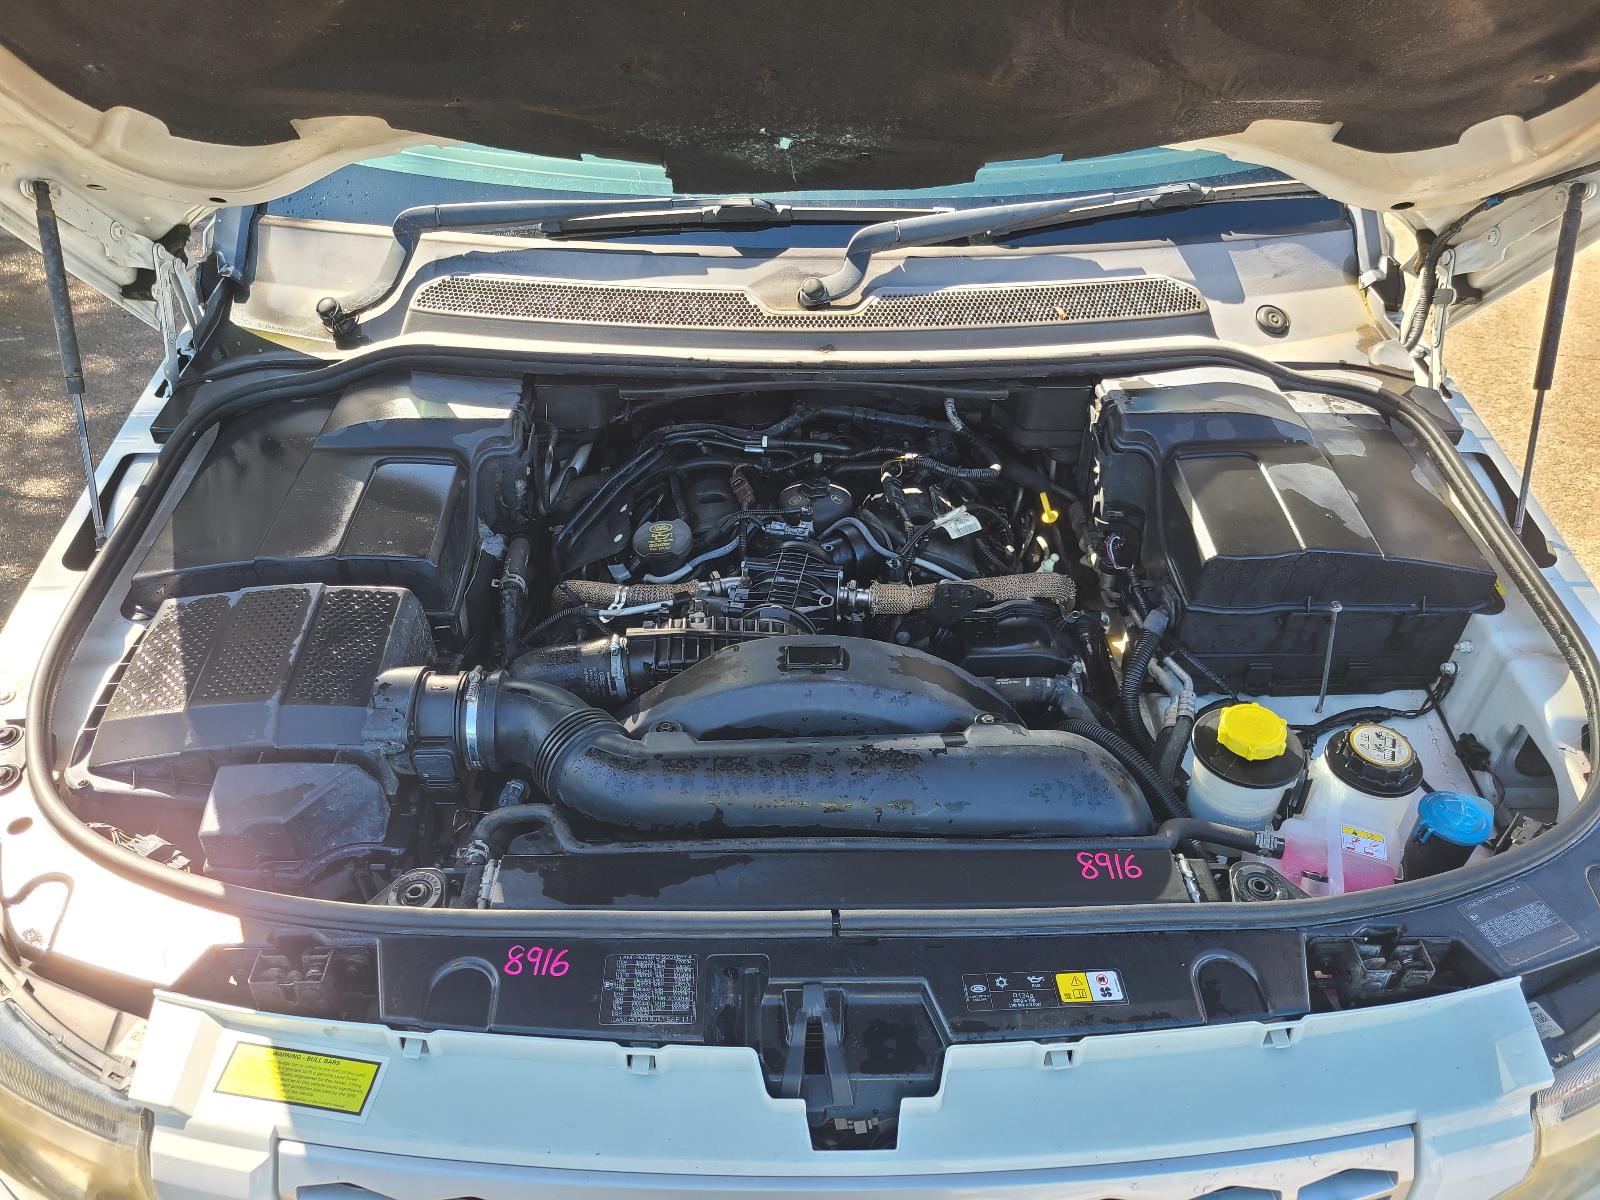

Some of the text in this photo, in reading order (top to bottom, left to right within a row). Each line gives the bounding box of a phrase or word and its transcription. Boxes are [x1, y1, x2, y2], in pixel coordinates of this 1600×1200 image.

[1077, 852, 1142, 880] 8916
[504, 945, 569, 977] 8916
[273, 1051, 302, 1060] WARNING
